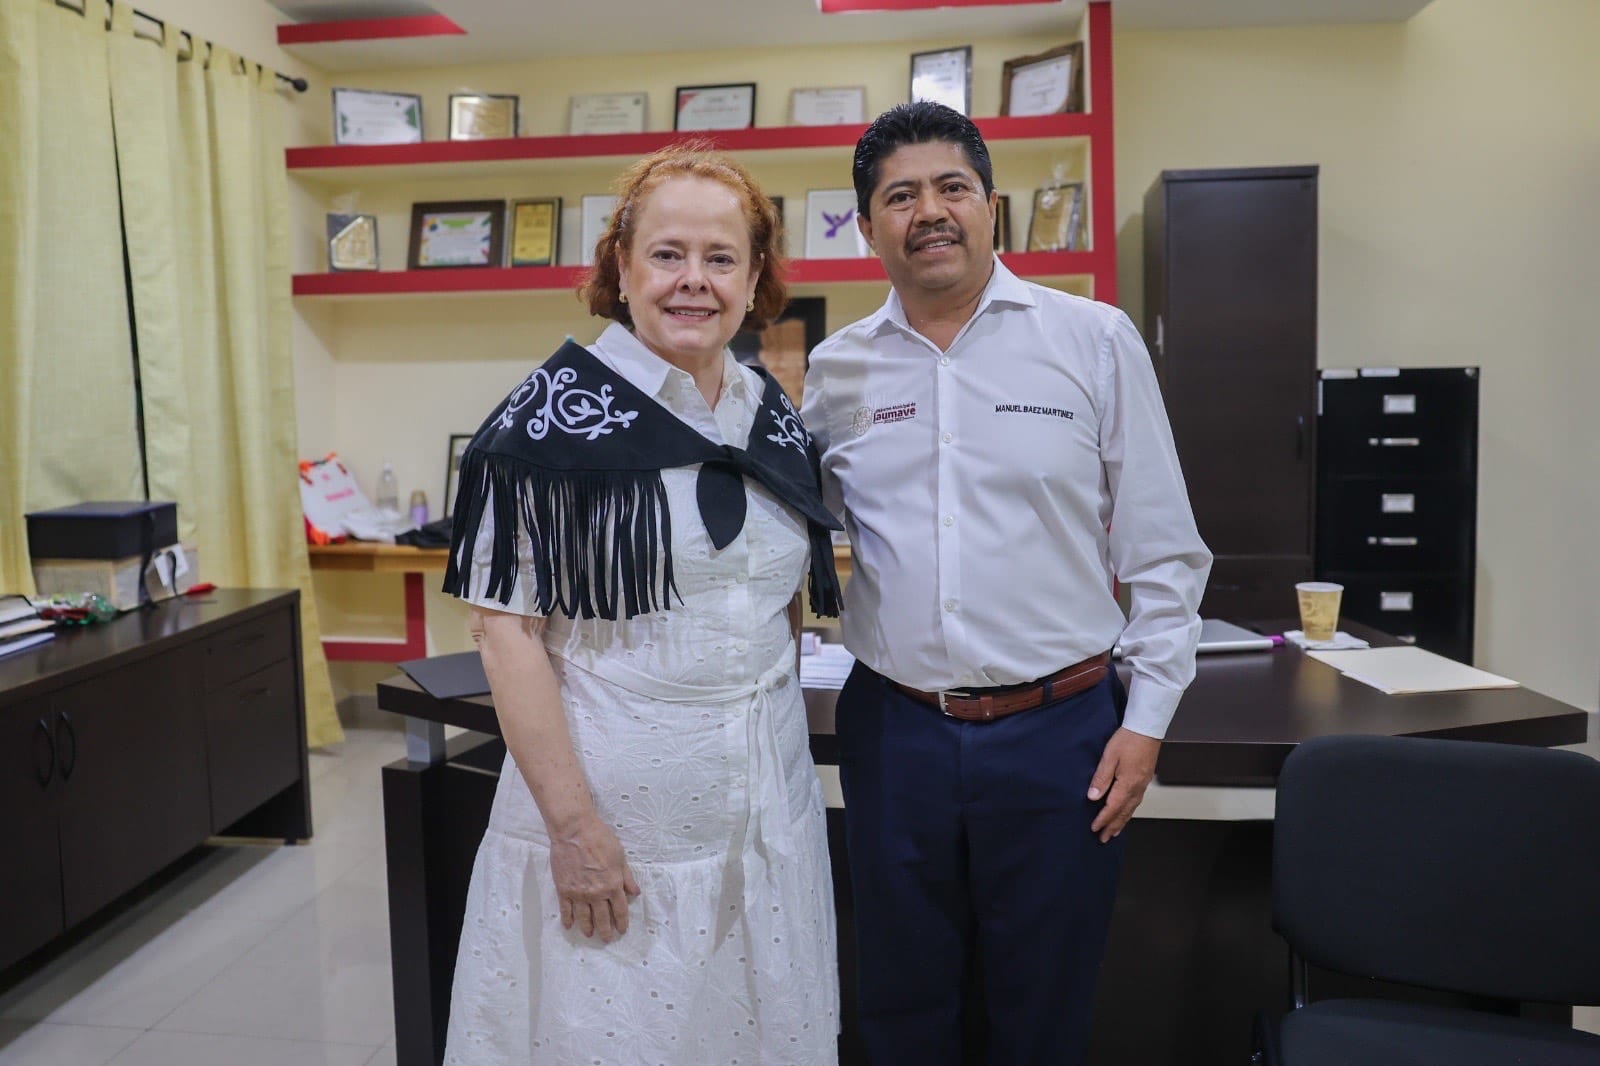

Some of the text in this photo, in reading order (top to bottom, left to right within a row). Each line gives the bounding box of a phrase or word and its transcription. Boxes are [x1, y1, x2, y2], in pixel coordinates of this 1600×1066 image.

[995, 404, 1074, 420] MANUEL BAEZ MARTINEZ
